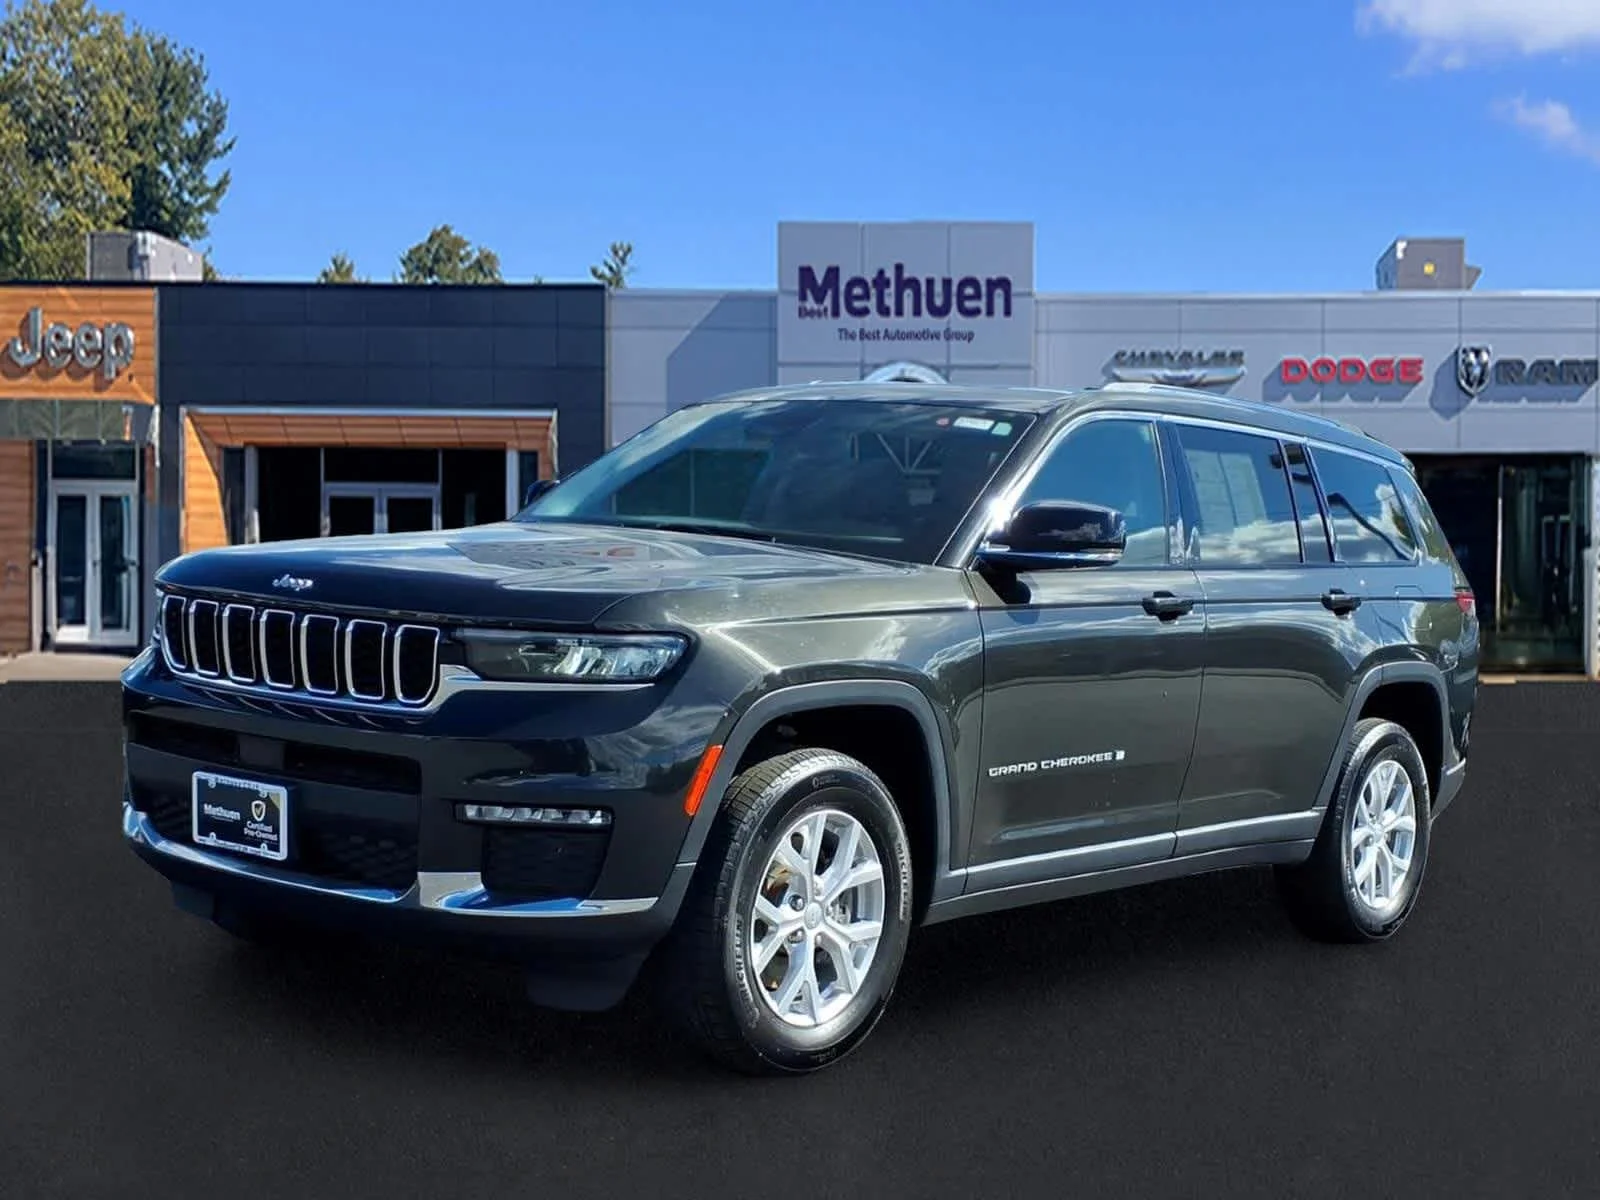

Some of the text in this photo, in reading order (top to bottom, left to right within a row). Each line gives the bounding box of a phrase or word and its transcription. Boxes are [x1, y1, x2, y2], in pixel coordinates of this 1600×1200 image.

[798, 263, 1012, 319] Methuen
[9, 307, 134, 379] Jeep
[838, 328, 975, 343] The Best Automotive Group
[1281, 358, 1424, 384] DODGE
[1495, 358, 1598, 385] RAM
[272, 574, 313, 591] Jeep
[989, 762, 1037, 777] GRAND
[1041, 752, 1113, 769] CHEROKEE
[203, 803, 241, 821] Methuen
